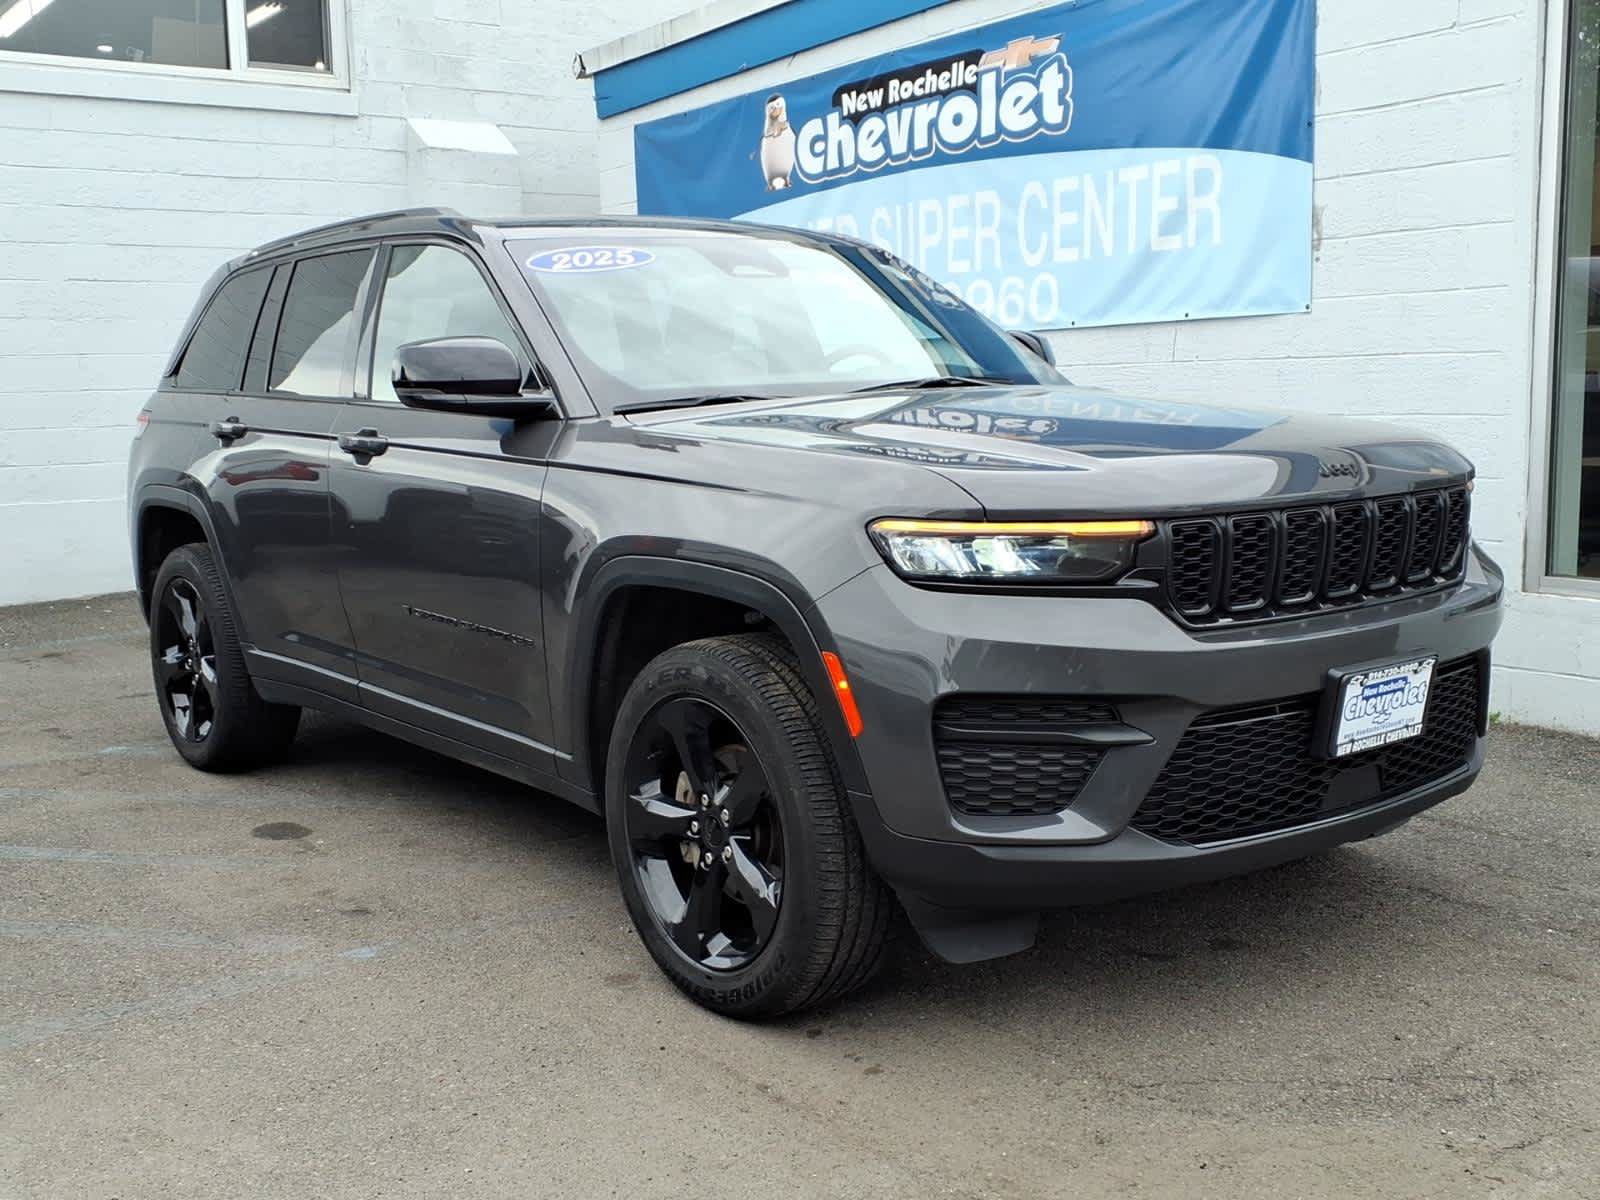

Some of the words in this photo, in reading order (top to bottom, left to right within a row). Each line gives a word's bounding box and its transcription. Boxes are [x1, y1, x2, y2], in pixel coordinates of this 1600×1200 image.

[841, 85, 883, 116] New
[888, 60, 977, 104] Rochelle
[797, 62, 1066, 176] Chevrolet
[870, 190, 1001, 273] SUPER
[1017, 153, 1223, 268] CENTER
[551, 249, 636, 271] 2025
[1319, 461, 1360, 487] Jeep
[1345, 681, 1428, 721] Chevrolet
[1379, 679, 1406, 694] Rochelle
[1352, 734, 1386, 753] ROCHELLE
[1386, 725, 1422, 744] CHEVROLET
